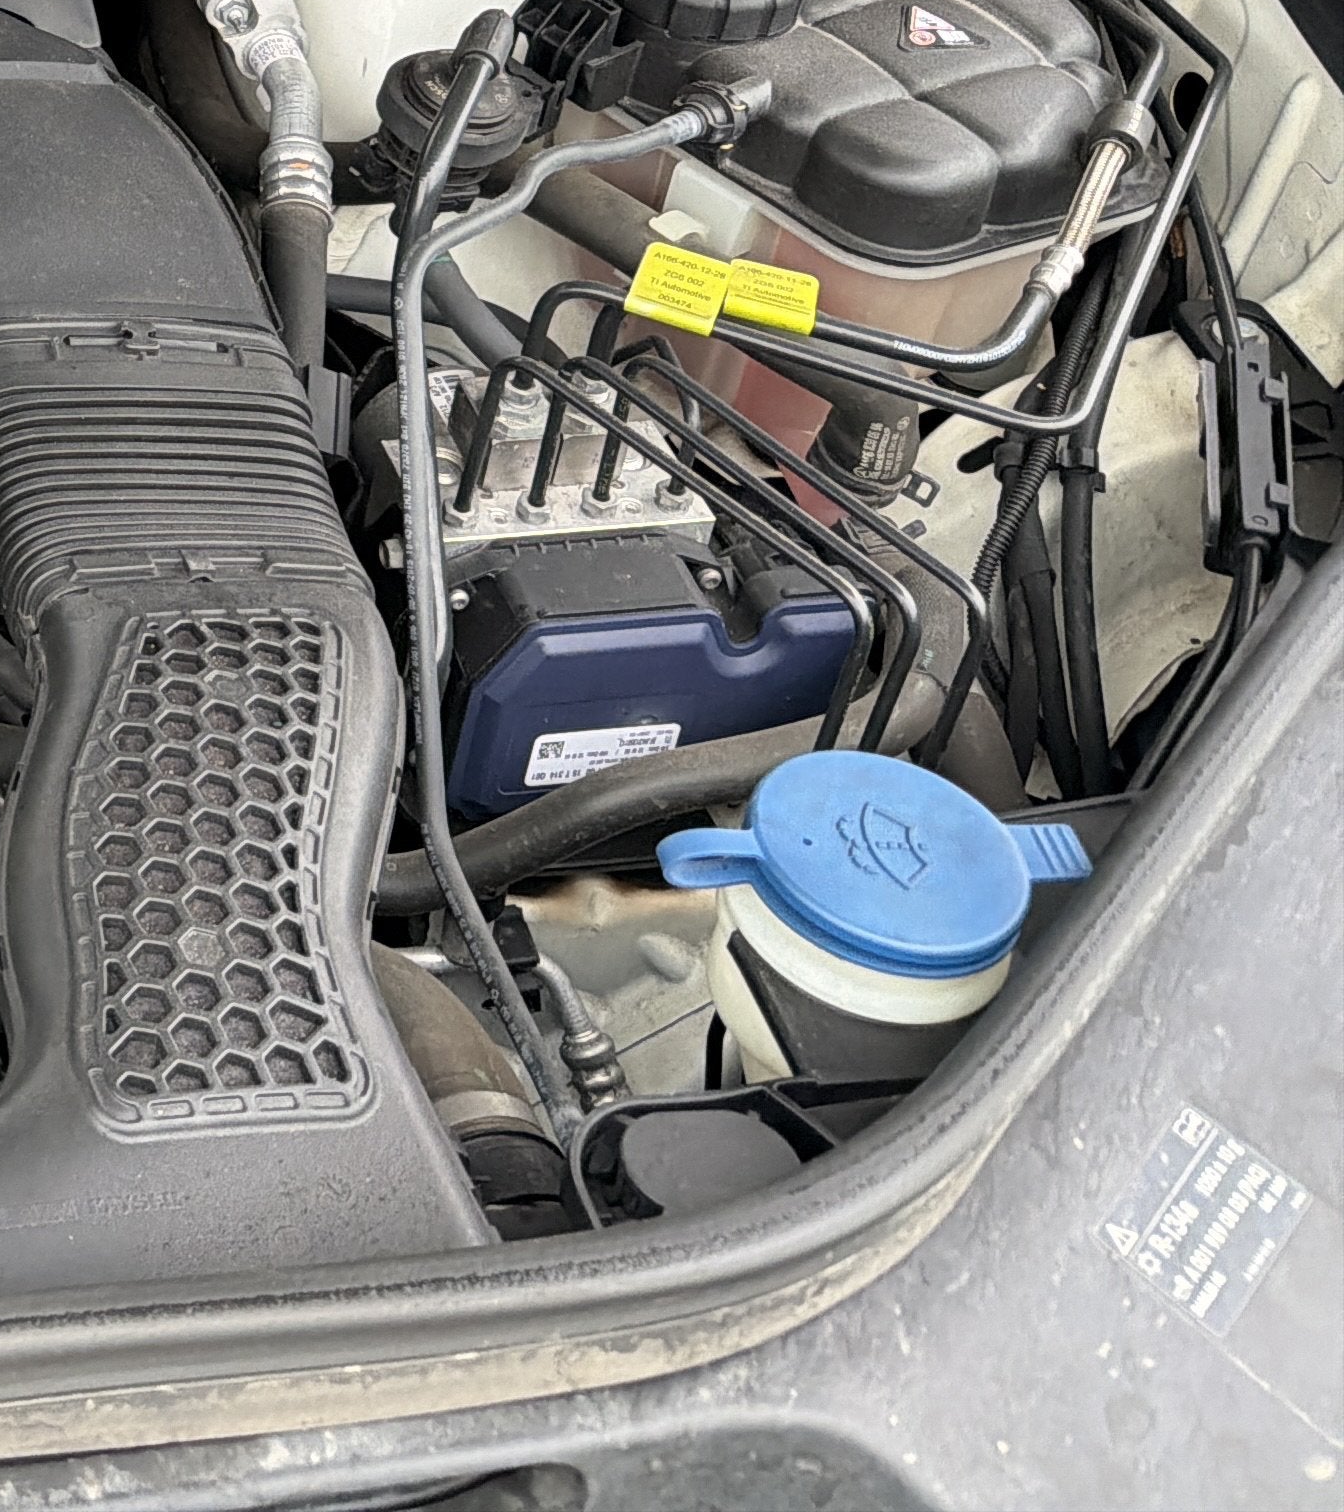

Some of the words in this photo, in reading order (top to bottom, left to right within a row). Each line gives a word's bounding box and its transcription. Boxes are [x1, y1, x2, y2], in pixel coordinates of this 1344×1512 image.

[662, 280, 711, 301] Automotive
[755, 287, 804, 304] Automotive
[1148, 1200, 1200, 1258] R-134a
